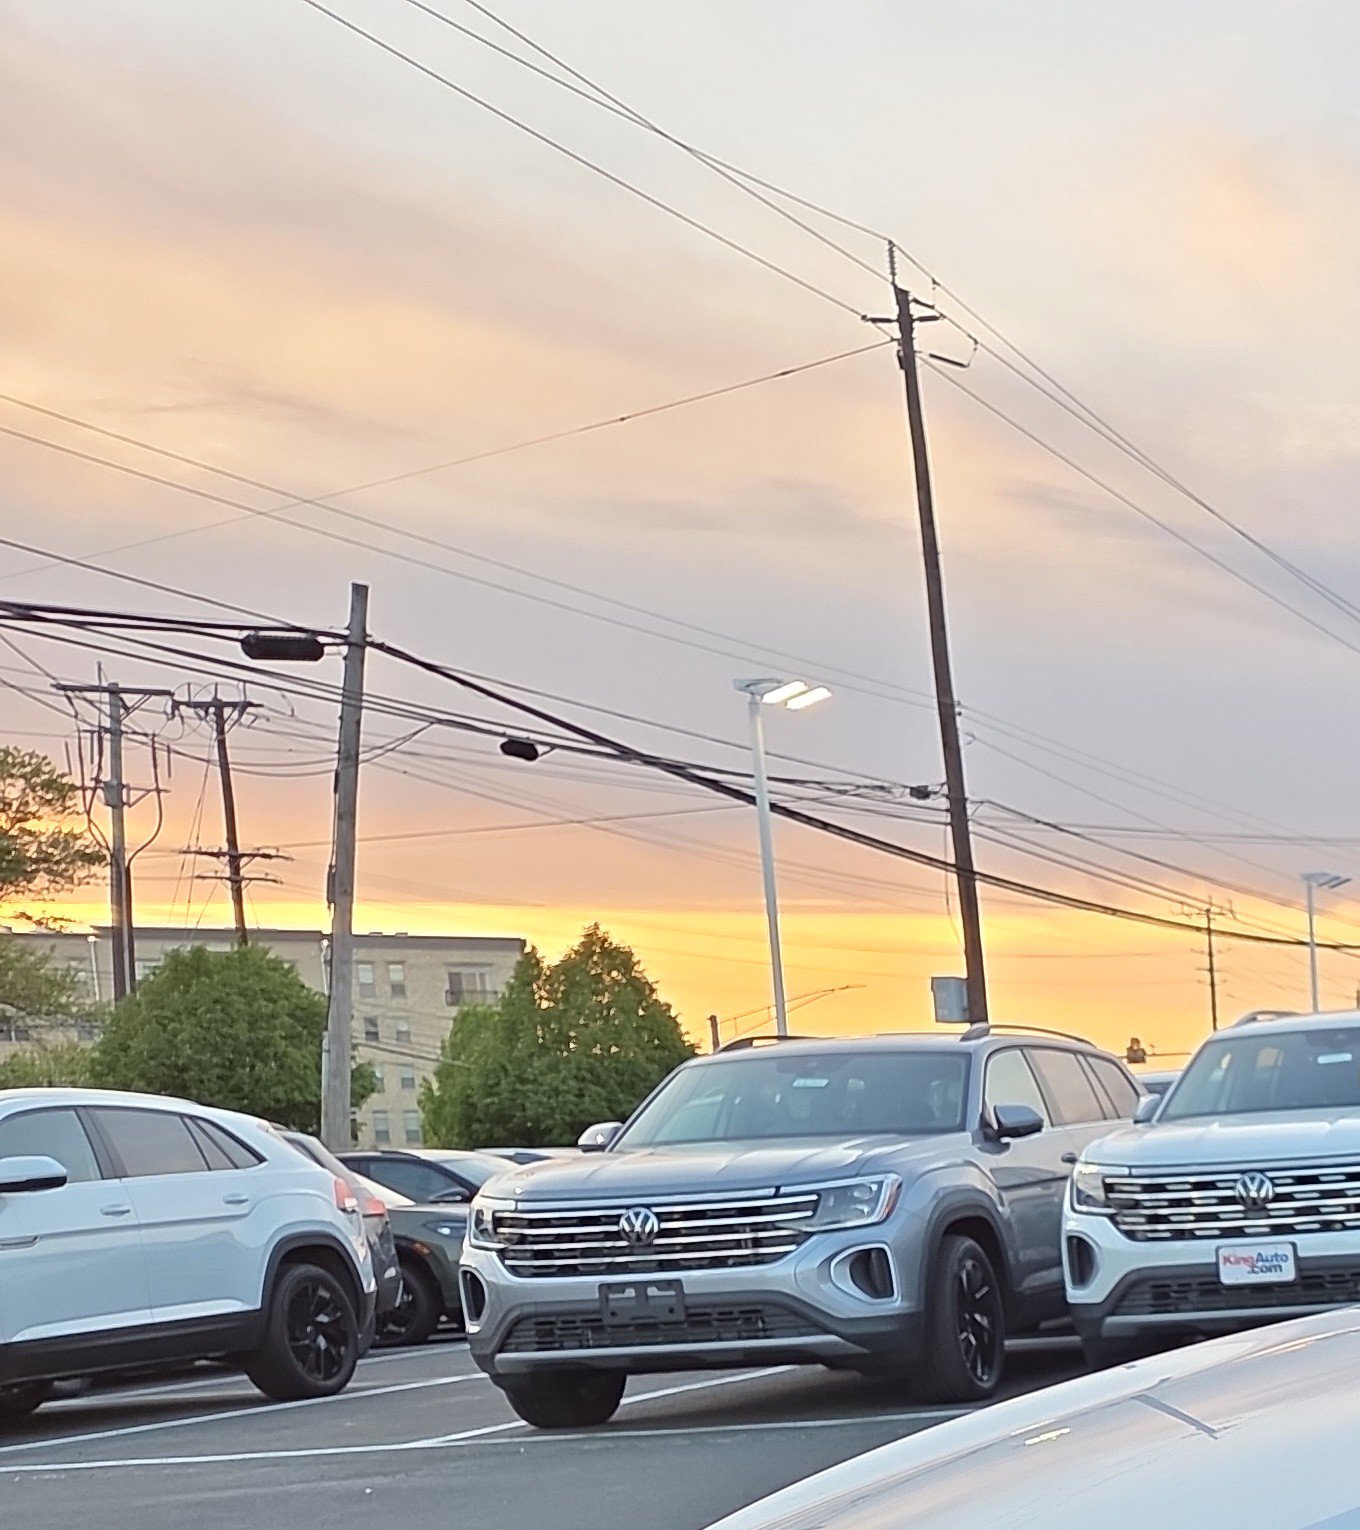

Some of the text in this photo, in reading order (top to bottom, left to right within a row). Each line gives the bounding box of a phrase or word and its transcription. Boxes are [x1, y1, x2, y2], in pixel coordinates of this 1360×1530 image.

[1236, 1171, 1273, 1209] VW
[619, 1207, 658, 1246] VW
[1222, 1252, 1289, 1270] KingAuto
